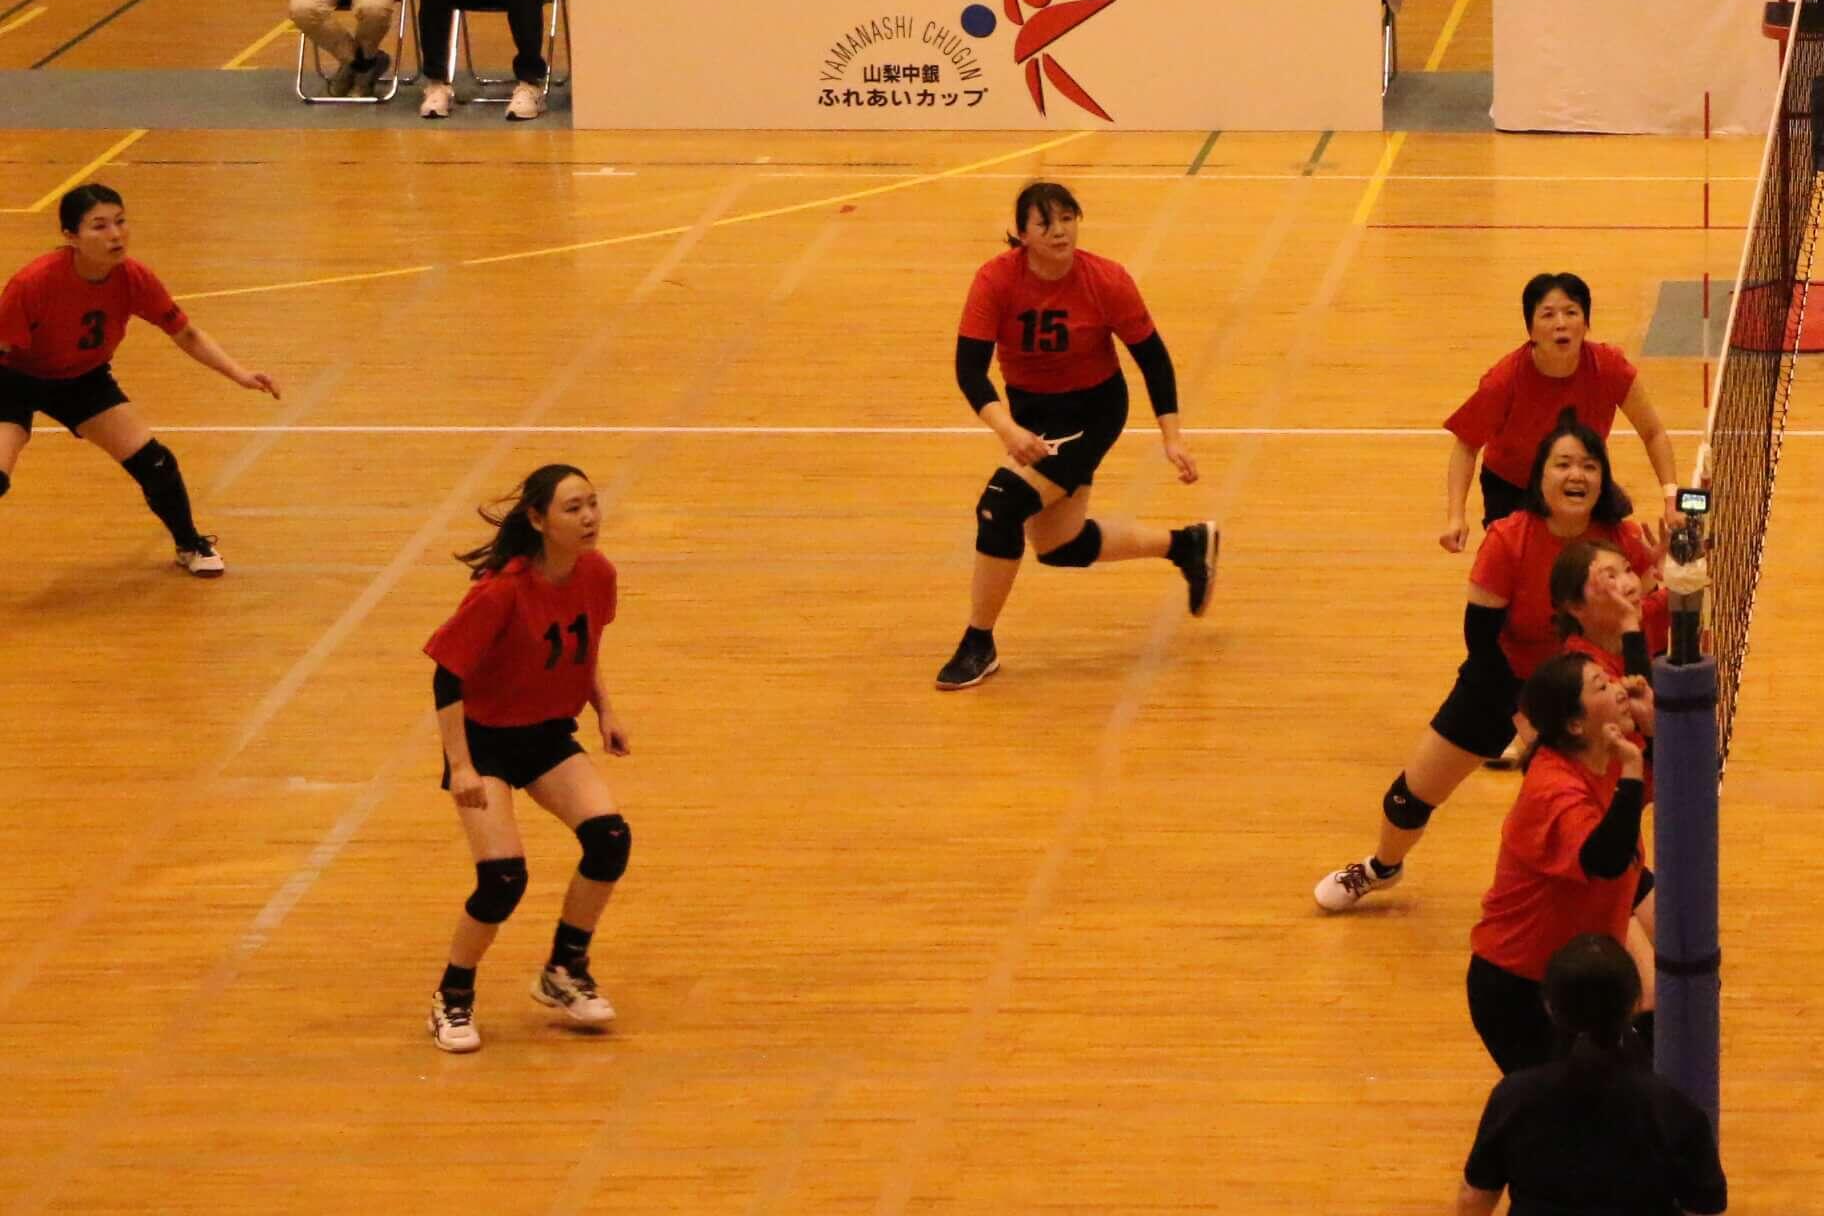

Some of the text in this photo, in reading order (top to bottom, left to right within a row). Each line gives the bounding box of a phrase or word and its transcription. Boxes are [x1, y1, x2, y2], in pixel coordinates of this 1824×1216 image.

[819, 15, 982, 83] YAMANASHI CHUGIN
[862, 63, 941, 85] 山梨中銀
[817, 87, 990, 109] ふれあいカップ
[77, 309, 107, 350] 3
[1016, 308, 1070, 353] 15
[543, 613, 589, 670] 11
